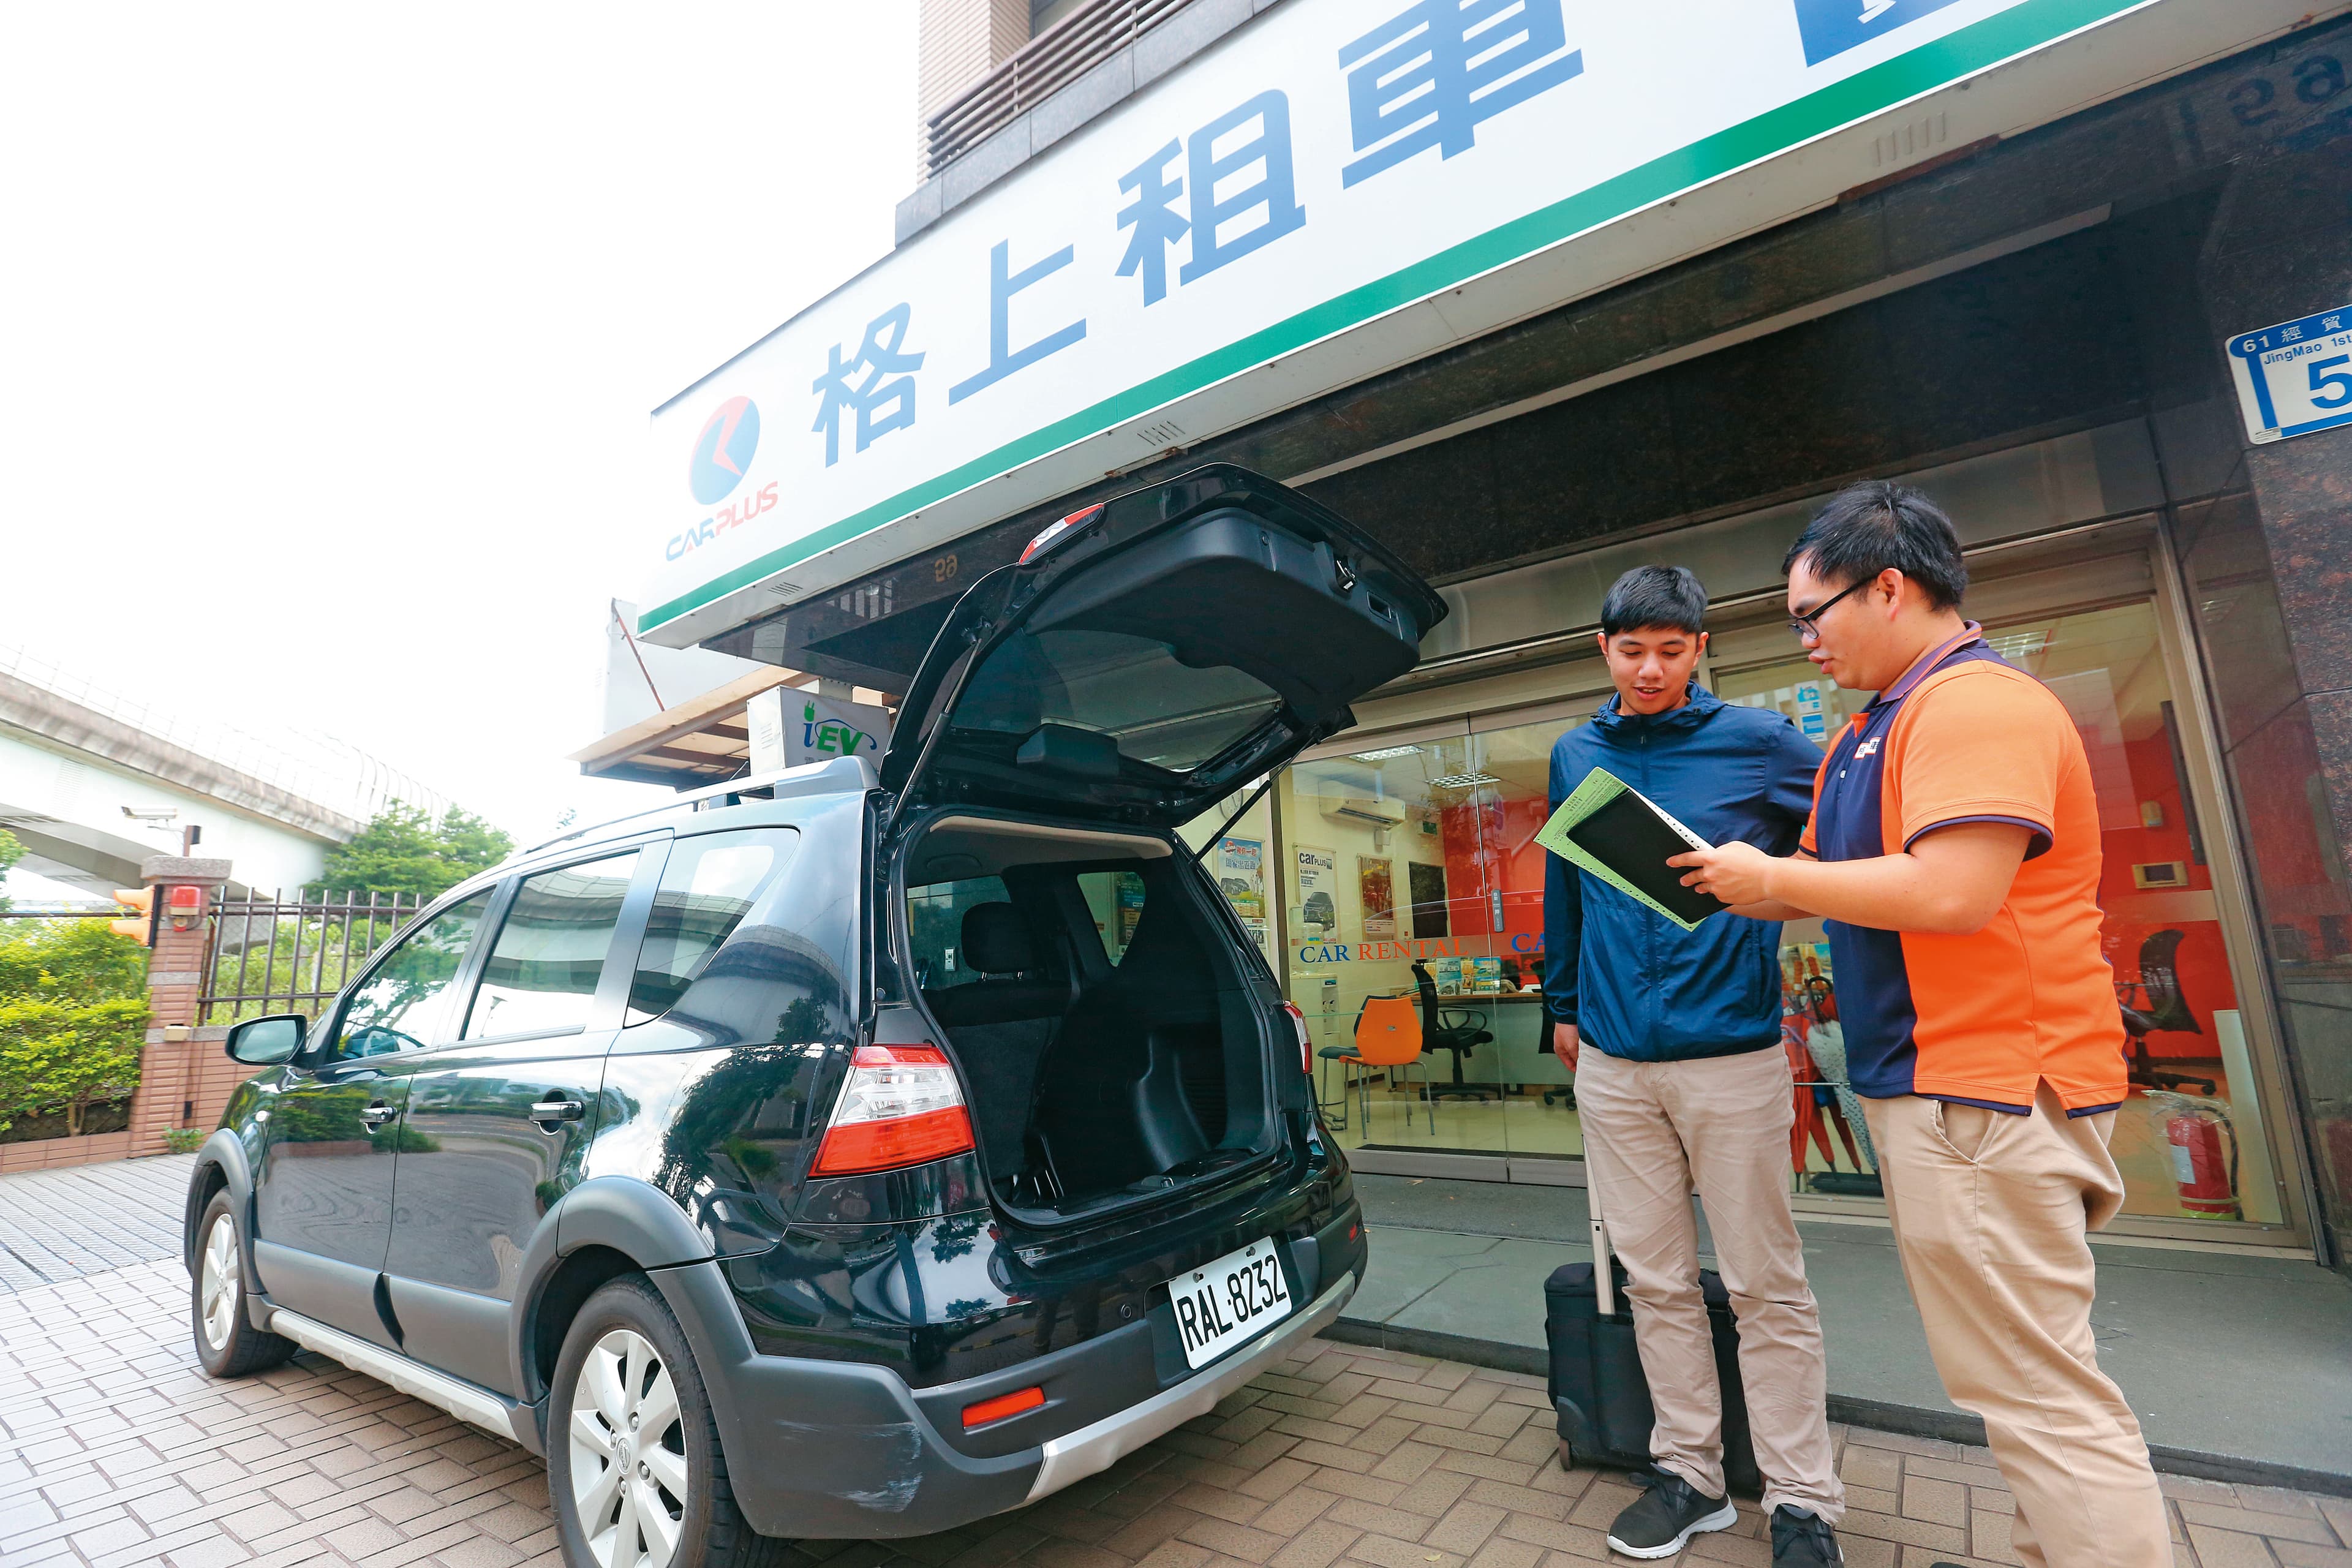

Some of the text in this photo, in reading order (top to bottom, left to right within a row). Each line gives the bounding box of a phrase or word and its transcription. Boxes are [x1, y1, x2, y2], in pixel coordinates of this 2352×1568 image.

[811, 0, 1585, 469] 格上租車
[2242, 315, 2343, 353] 61 經貿
[2264, 343, 2323, 364] JingMao
[2308, 353, 2352, 409] 5
[1300, 938, 1469, 963] CAR RENTAL
[1511, 933, 1545, 952] CA
